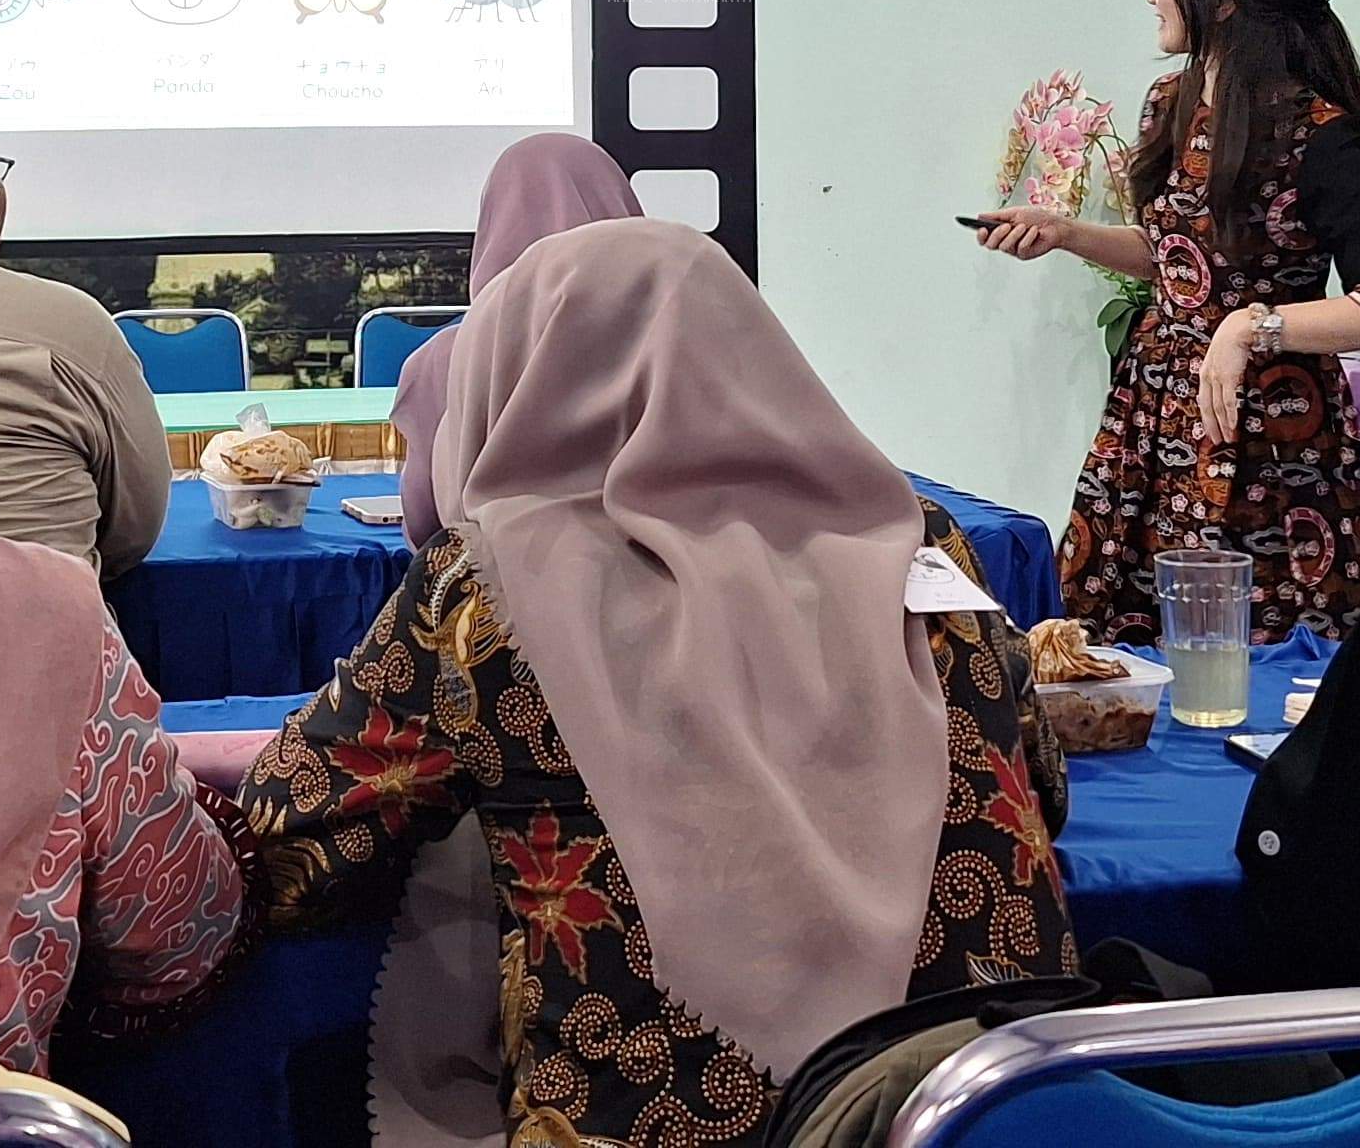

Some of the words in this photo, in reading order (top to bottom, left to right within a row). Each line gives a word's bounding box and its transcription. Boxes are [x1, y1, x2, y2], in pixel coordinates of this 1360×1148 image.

[0, 84, 36, 101] Zou
[153, 78, 215, 94] Panda
[301, 83, 385, 100] Choucho
[478, 81, 504, 96] Ari
